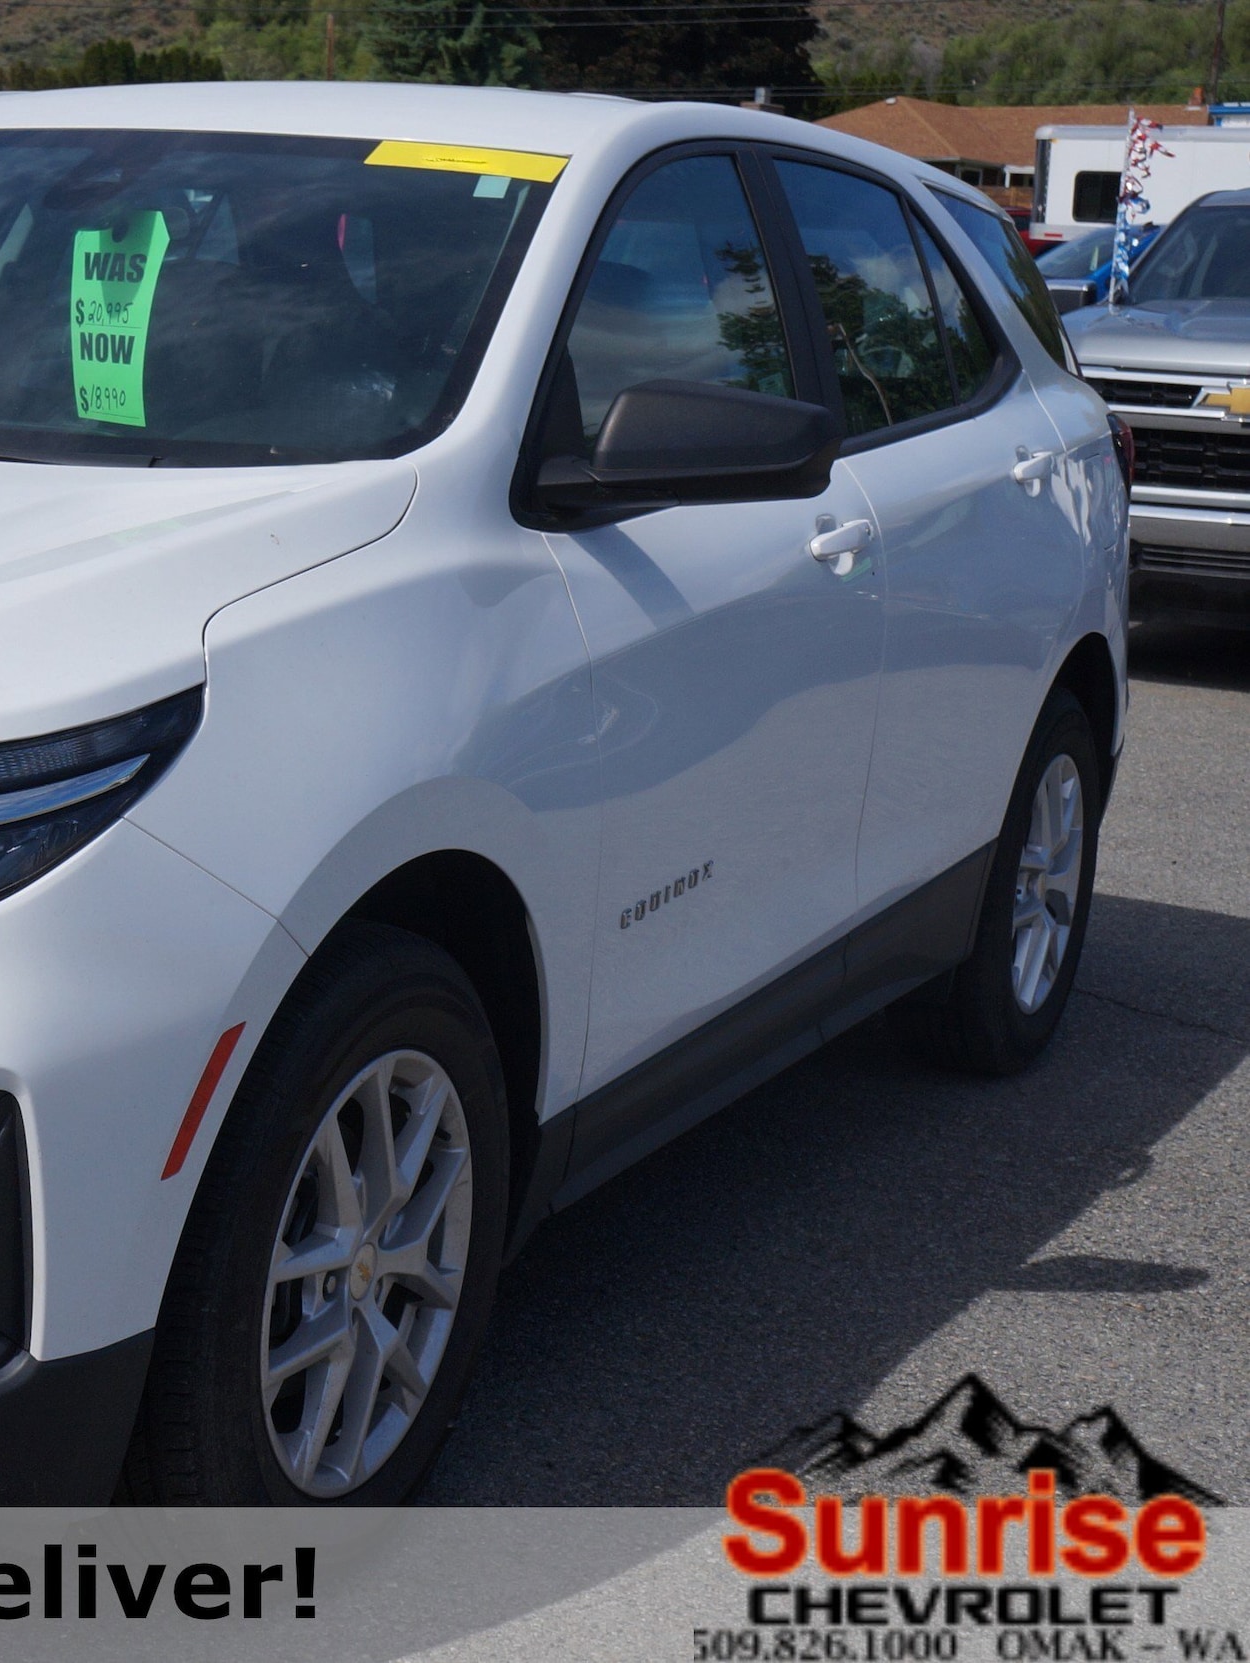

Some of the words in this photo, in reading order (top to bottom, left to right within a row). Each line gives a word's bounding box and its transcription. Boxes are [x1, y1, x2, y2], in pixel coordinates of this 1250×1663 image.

[84, 252, 148, 283] WAS
[79, 332, 136, 365] NOW
[620, 859, 714, 929] EQUINOX
